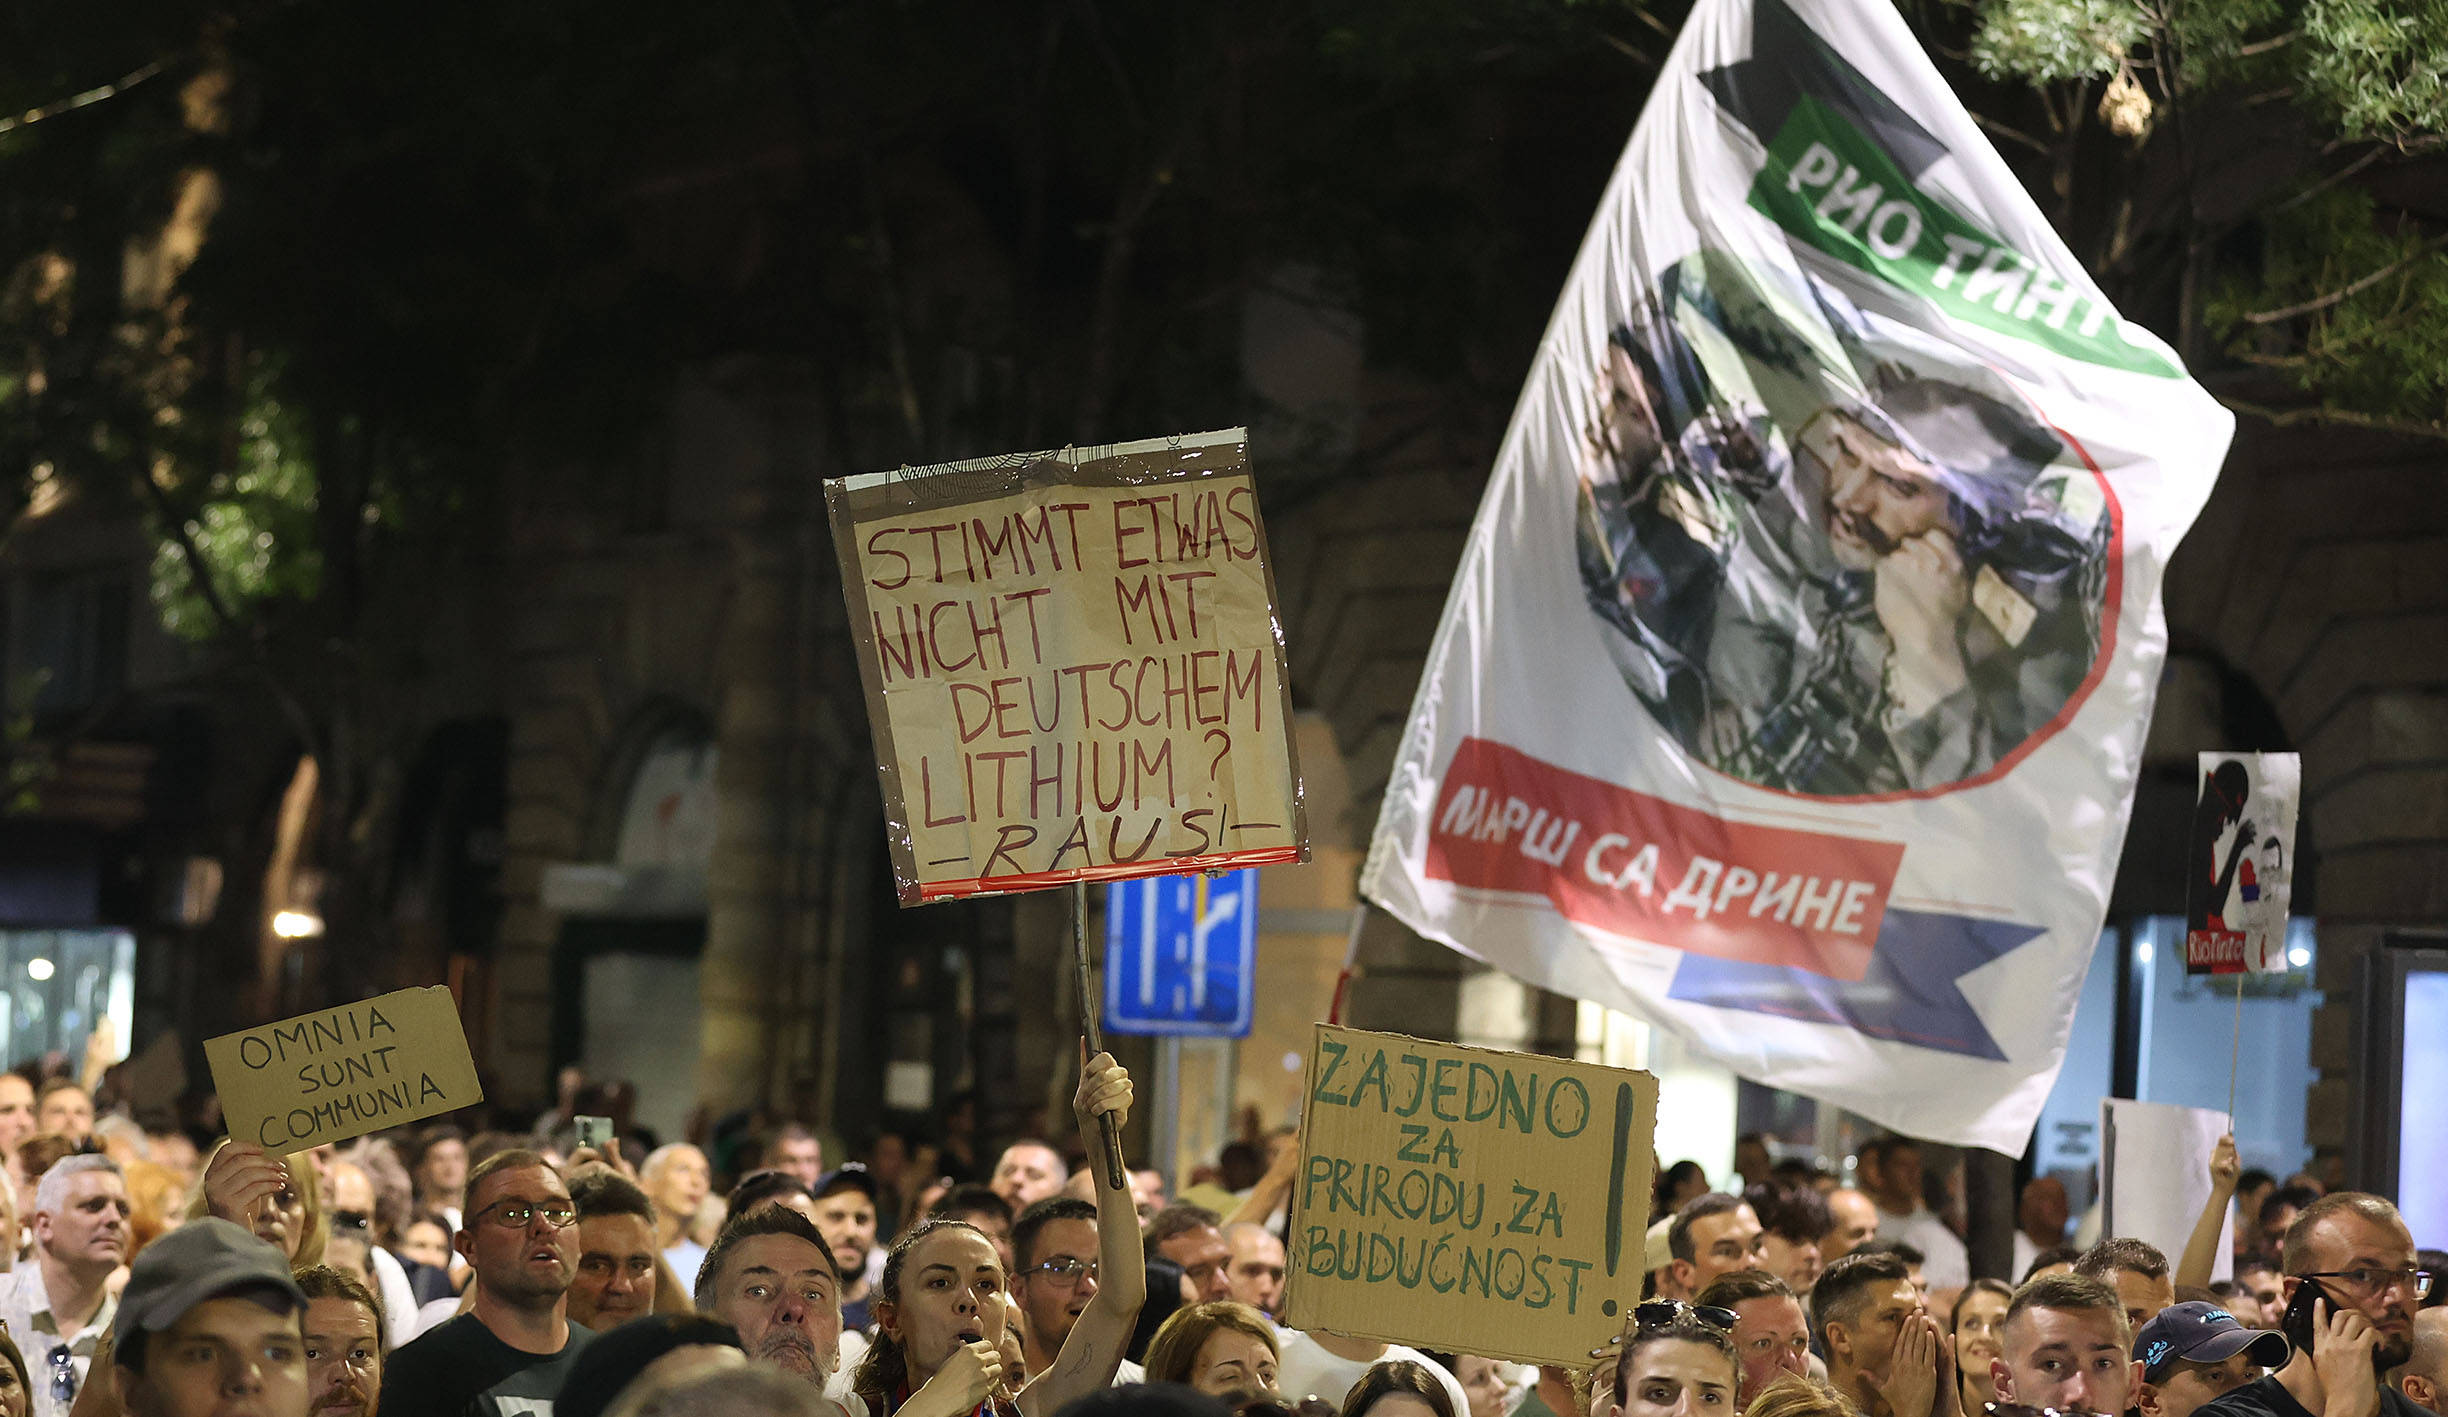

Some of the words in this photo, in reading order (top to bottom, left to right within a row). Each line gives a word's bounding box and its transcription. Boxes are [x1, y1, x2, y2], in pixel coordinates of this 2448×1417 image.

[1785, 141, 1923, 260] РИО
[867, 502, 1090, 590] STIMMT
[1112, 487, 1259, 569] ETWAS
[874, 588, 1051, 683] NICHT
[1115, 571, 1217, 645] MIT
[950, 649, 1263, 745] DEUTSCHEM
[1439, 784, 1582, 868] МАРШ
[1583, 831, 1660, 897] СА
[1662, 858, 1876, 935] ДРИНЕ
[240, 1006, 395, 1069] OMNIA
[299, 1045, 397, 1094] SUNT
[259, 1072, 446, 1148] COMMUNIA
[1314, 1041, 1591, 1139] ZAJEDNO
[1397, 1124, 1460, 1169] ZA
[1506, 1184, 1563, 1238] ZA
[1306, 1225, 1594, 1315] BUDUĆNOST
